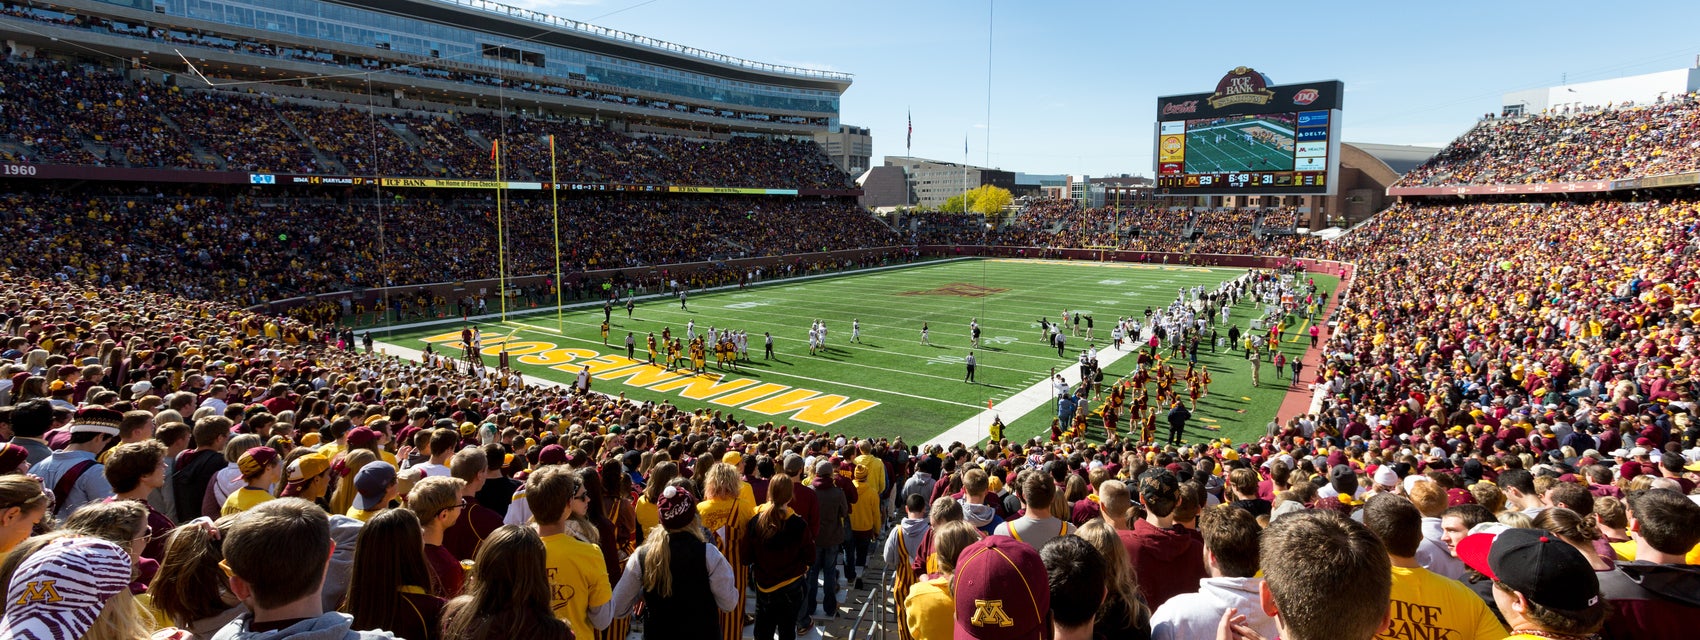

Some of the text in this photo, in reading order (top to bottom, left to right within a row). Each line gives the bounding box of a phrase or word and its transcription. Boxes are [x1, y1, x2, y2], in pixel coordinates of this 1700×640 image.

[478, 65, 525, 77] MINNESOTA
[1230, 77, 1252, 87] TCF
[1226, 85, 1254, 95] BANK
[1299, 92, 1314, 101] DQ
[4, 164, 37, 176] 1960
[310, 176, 320, 184] 14
[354, 177, 362, 185] 17
[1200, 175, 1212, 185] 29
[1229, 173, 1250, 183] 6:49
[1262, 174, 1274, 184] 31
[418, 329, 881, 427] MINNESOTA
[15, 580, 64, 606] M
[970, 599, 1014, 628] M
[1389, 599, 1442, 627] TCF
[1379, 619, 1463, 640] BANK
